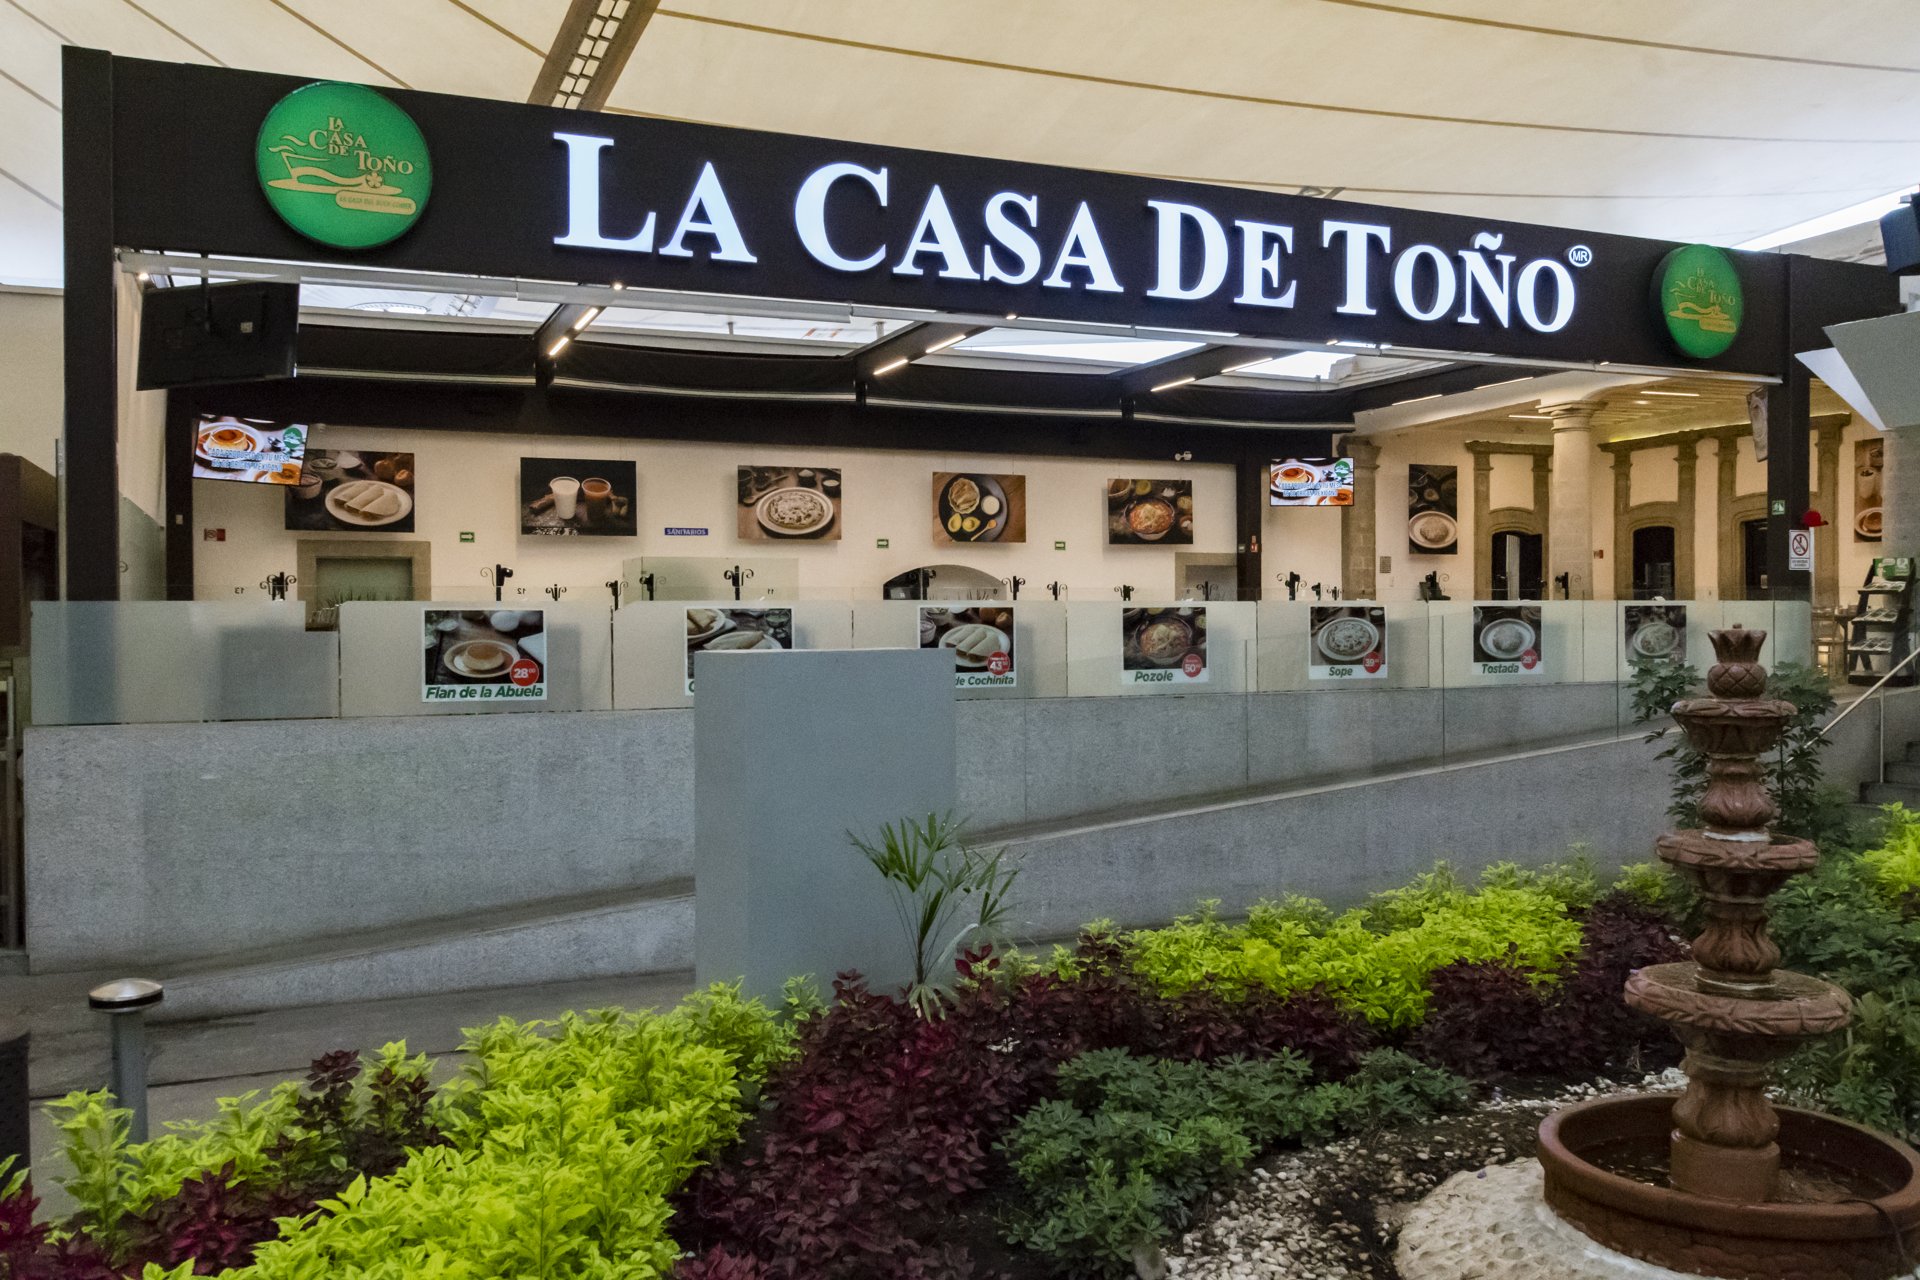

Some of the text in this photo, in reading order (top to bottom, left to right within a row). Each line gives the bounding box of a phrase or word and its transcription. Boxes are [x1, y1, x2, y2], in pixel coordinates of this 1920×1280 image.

[329, 117, 344, 131] LA
[309, 130, 368, 150] CASA
[328, 144, 349, 156] DE
[354, 150, 414, 174] TOÑO
[553, 132, 758, 264] LA
[795, 162, 1124, 293] CASA
[1146, 199, 1297, 309] DE
[1323, 219, 1576, 333] TOÑO
[1329, 666, 1353, 678] Sope
[1482, 663, 1520, 674] Tostada
[967, 674, 1015, 686] Cochinita
[1135, 670, 1173, 682] Pozole
[425, 684, 543, 699] Flan de la Abuela
